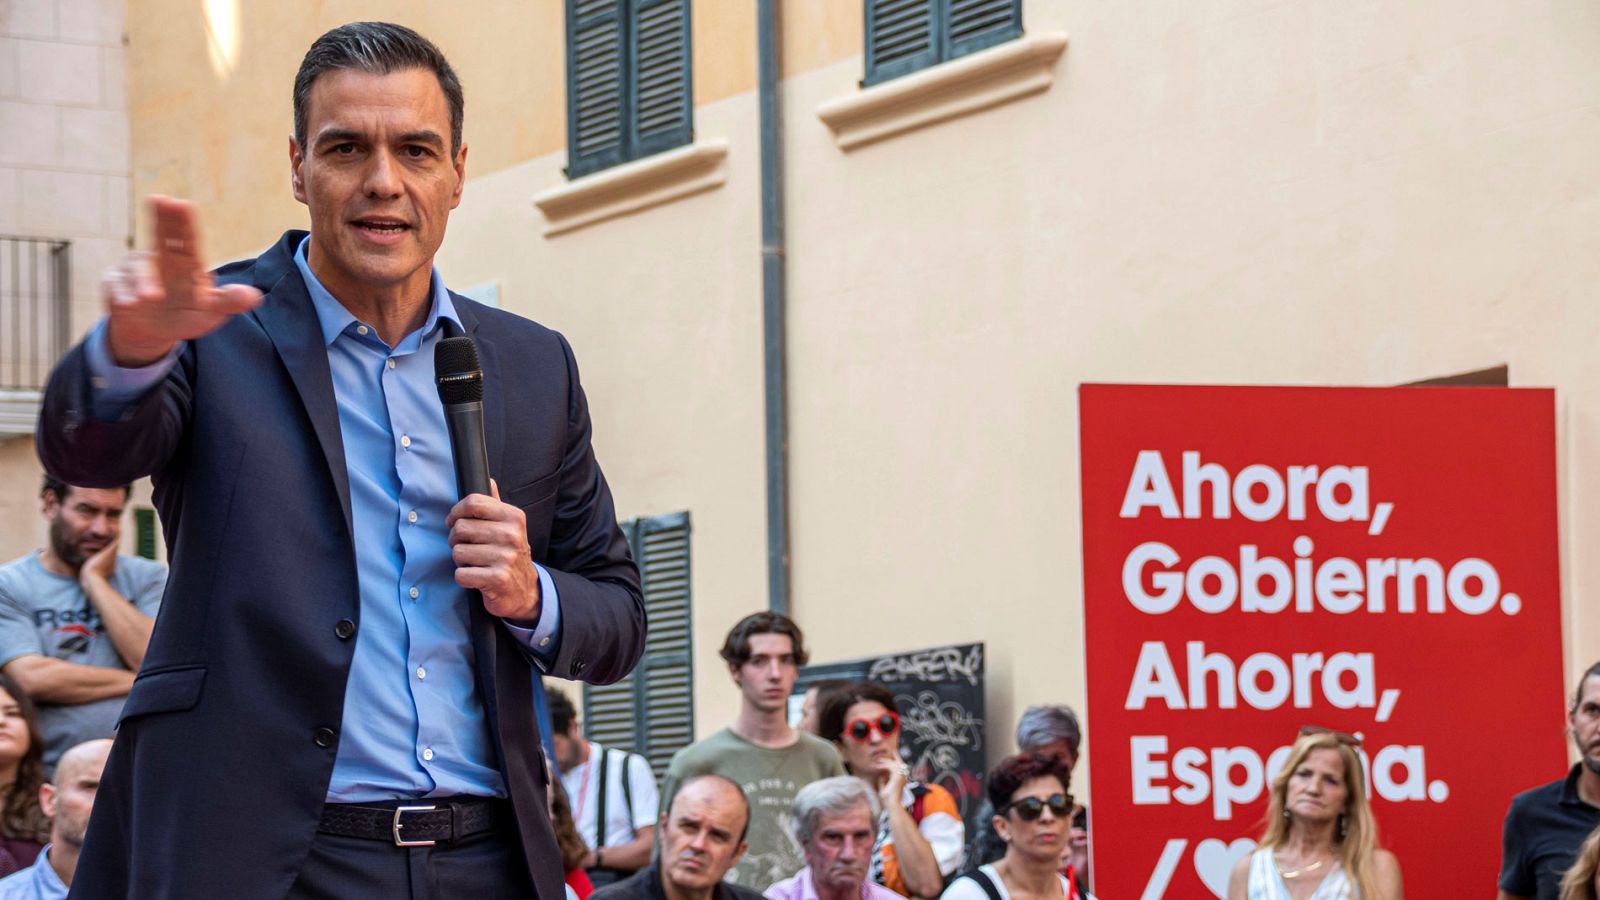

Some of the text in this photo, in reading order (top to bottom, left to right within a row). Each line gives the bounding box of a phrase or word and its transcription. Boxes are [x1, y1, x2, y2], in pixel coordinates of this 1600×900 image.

[1119, 450, 1394, 535] Ahora,
[1122, 535, 1522, 616] Gobierno.
[1124, 640, 1400, 722] Ahora,
[1130, 733, 1449, 820] Espa.
